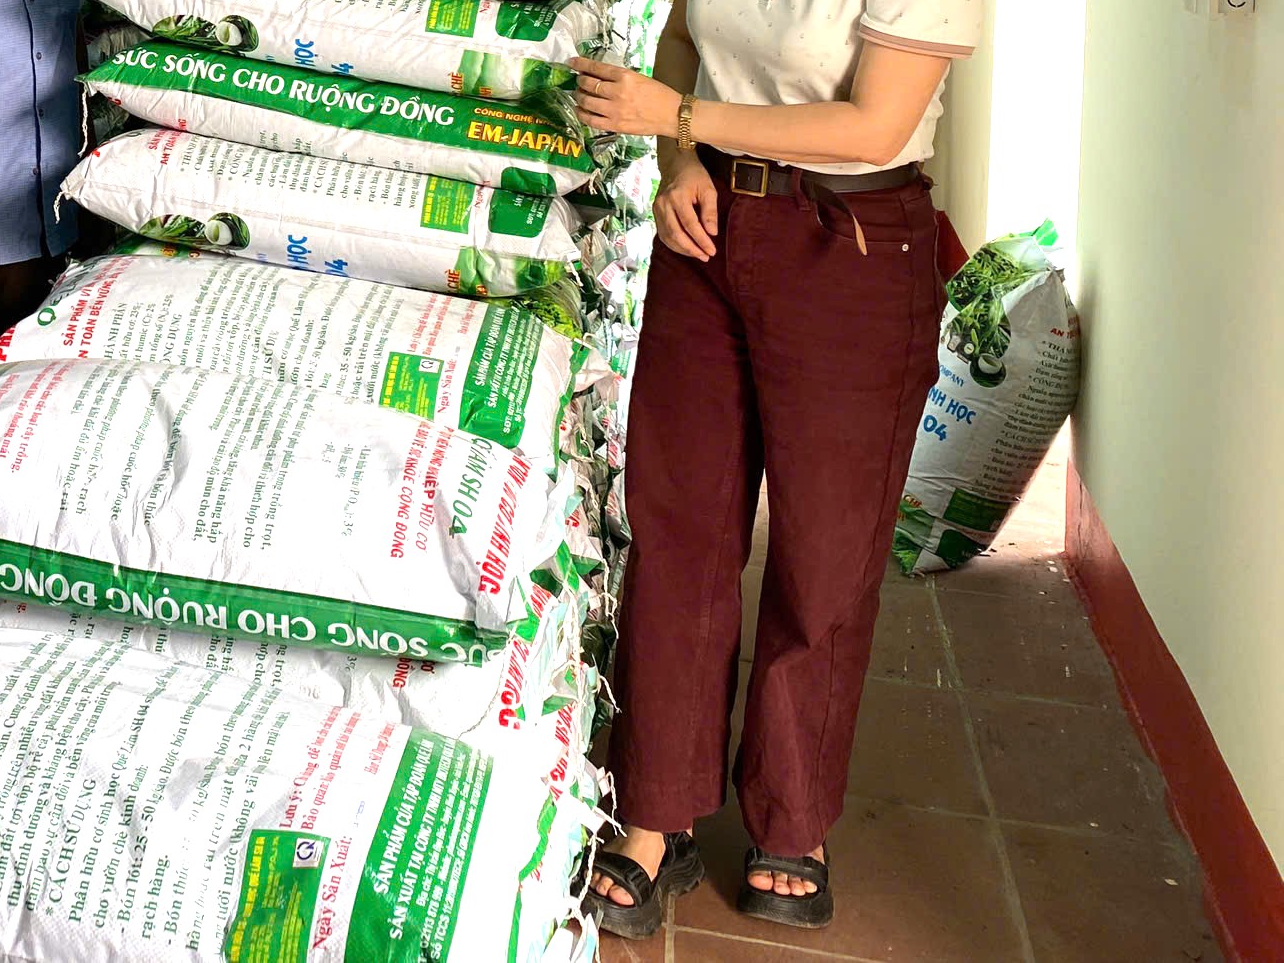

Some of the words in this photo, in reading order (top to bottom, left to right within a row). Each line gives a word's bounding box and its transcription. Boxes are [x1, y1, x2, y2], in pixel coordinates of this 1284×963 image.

[293, 38, 318, 67] HỌC
[112, 48, 158, 69] SỨC
[163, 53, 226, 83] SỐNG
[232, 68, 284, 95] CHO
[288, 80, 375, 113] RUỘNG
[380, 94, 455, 126] ĐỒNG
[474, 106, 504, 120] CÔNG
[467, 121, 584, 158] EM-JAPAN
[63, 324, 77, 347] SẢN
[81, 319, 95, 346] TOÀN
[923, 413, 947, 442] 04
[948, 396, 977, 426] HỌC
[391, 521, 409, 559] ĐỒNG
[237, 609, 316, 642] CHO
[328, 622, 430, 658] SỐNG
[16, 842, 33, 877] dinh
[330, 835, 352, 872] Xuất:
[48, 846, 73, 903] CÁCH
[148, 854, 170, 902] hàng.
[322, 876, 342, 904] Sản
[68, 884, 91, 923] Phân
[95, 899, 110, 928] cho
[117, 889, 135, 922] Bón
[165, 897, 183, 935] Bón
[142, 904, 159, 940] rạch
[312, 905, 336, 951] Ngày
